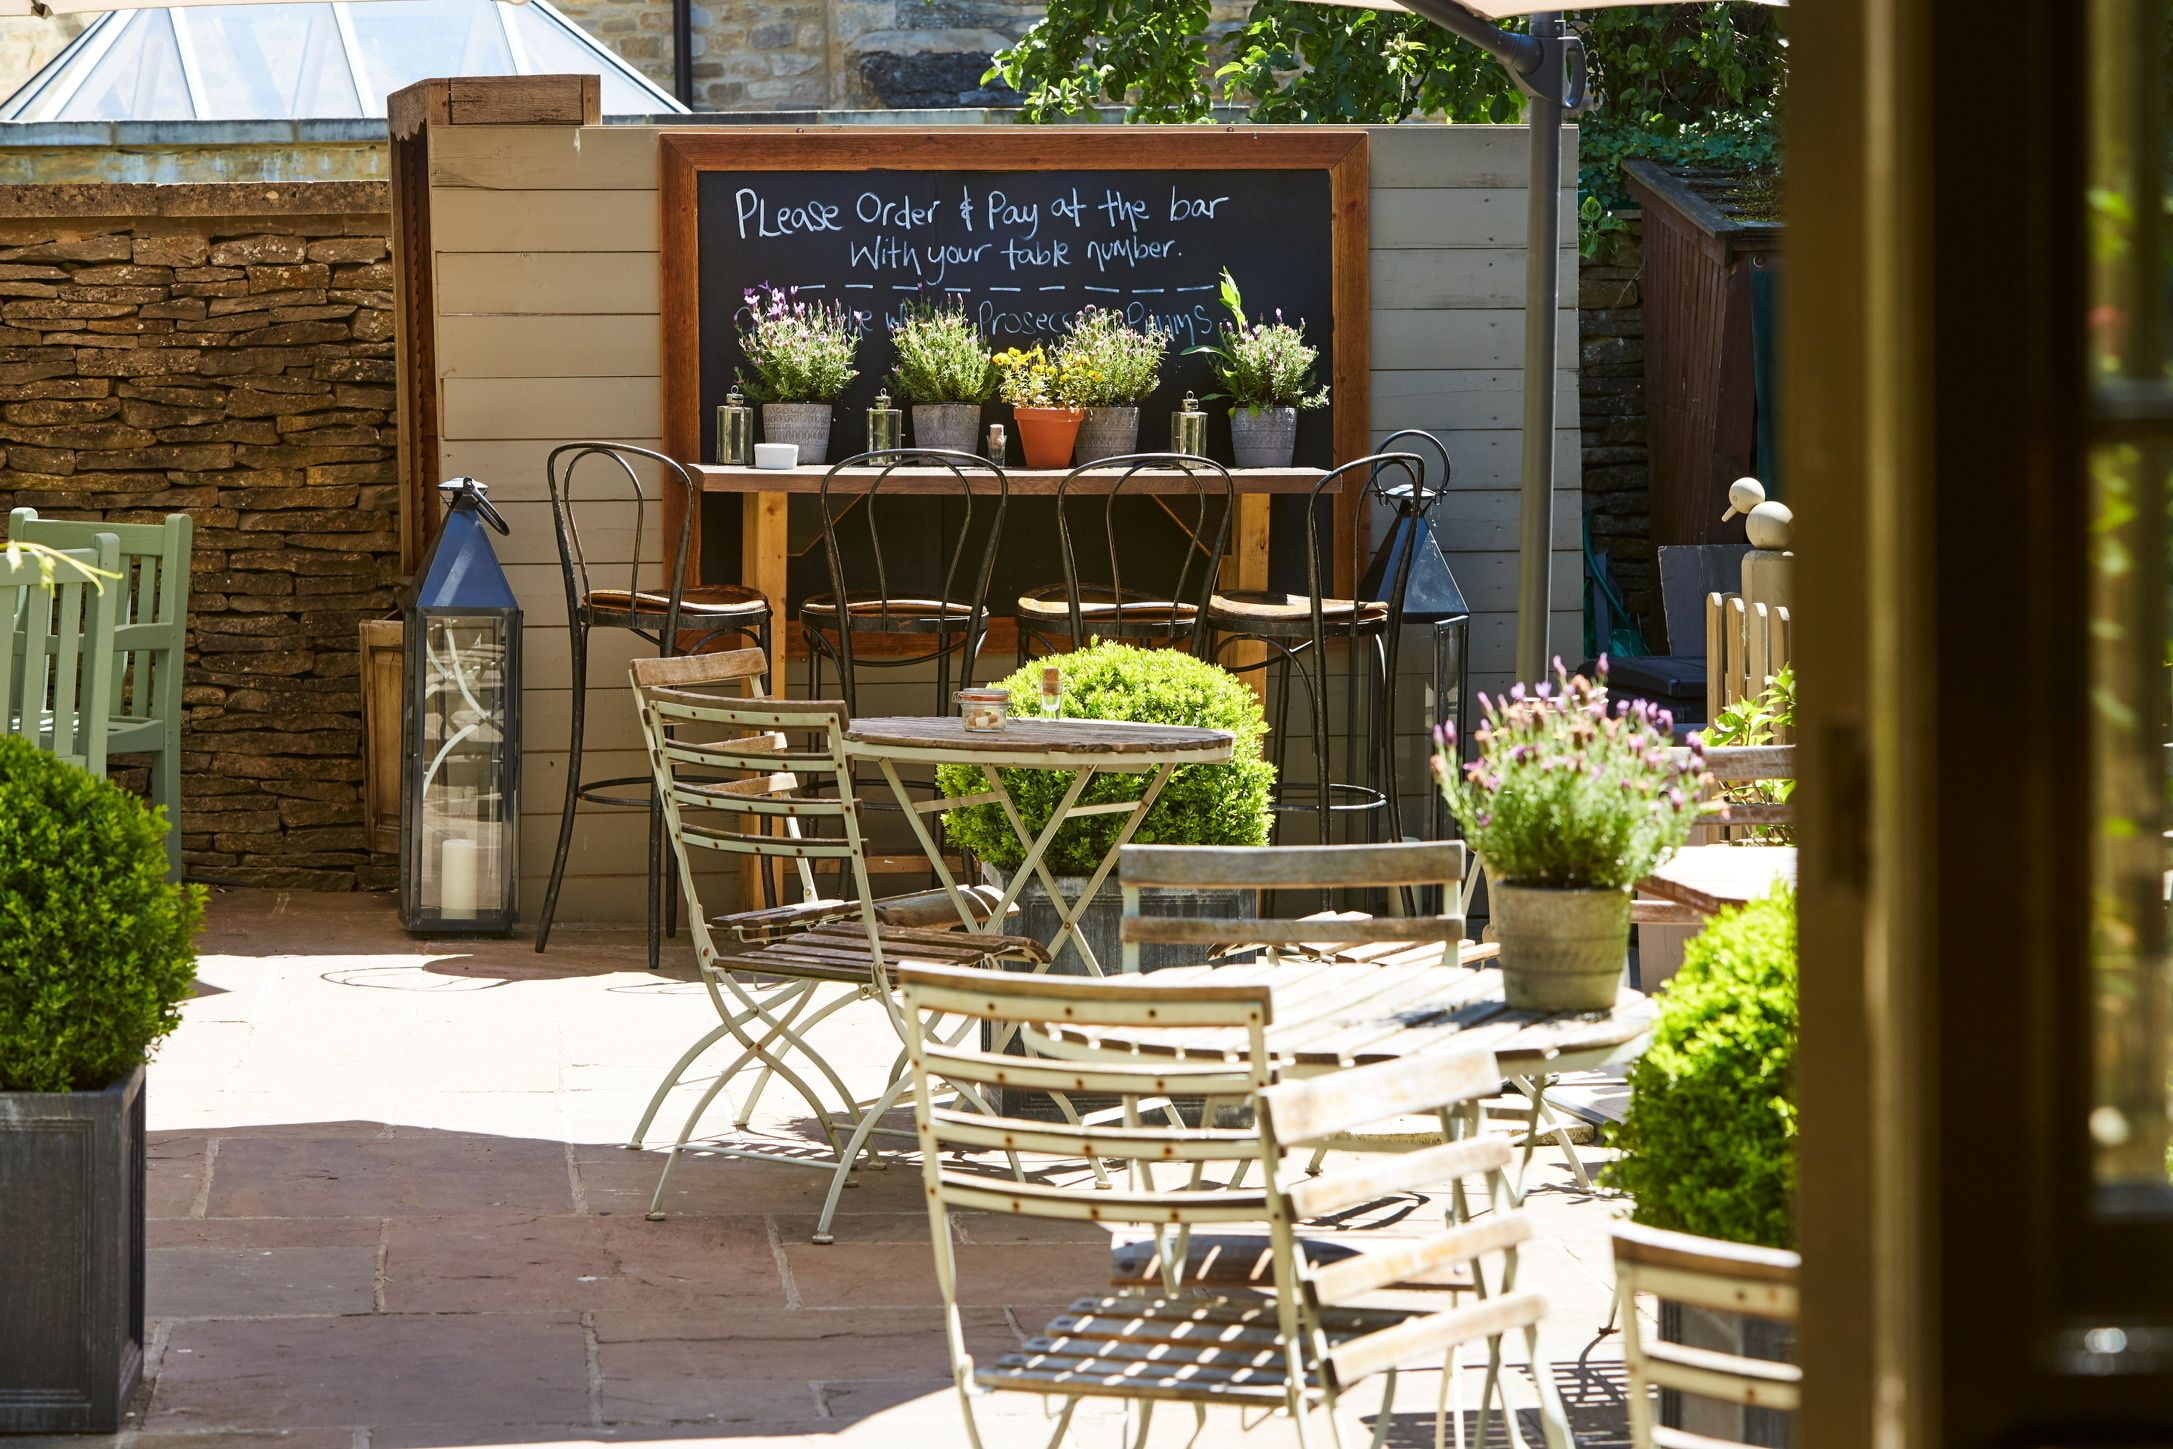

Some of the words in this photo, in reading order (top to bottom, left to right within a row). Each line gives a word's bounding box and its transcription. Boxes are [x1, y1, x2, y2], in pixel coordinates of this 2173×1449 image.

[856, 191, 942, 230] Order
[959, 184, 974, 232] &
[987, 190, 1038, 241] Pay
[1050, 187, 1088, 228] at
[1097, 188, 1150, 233] the
[1169, 184, 1231, 222] bar
[850, 234, 923, 277] With
[925, 243, 993, 287] your
[999, 237, 1073, 272] table
[1086, 235, 1183, 273] number.
